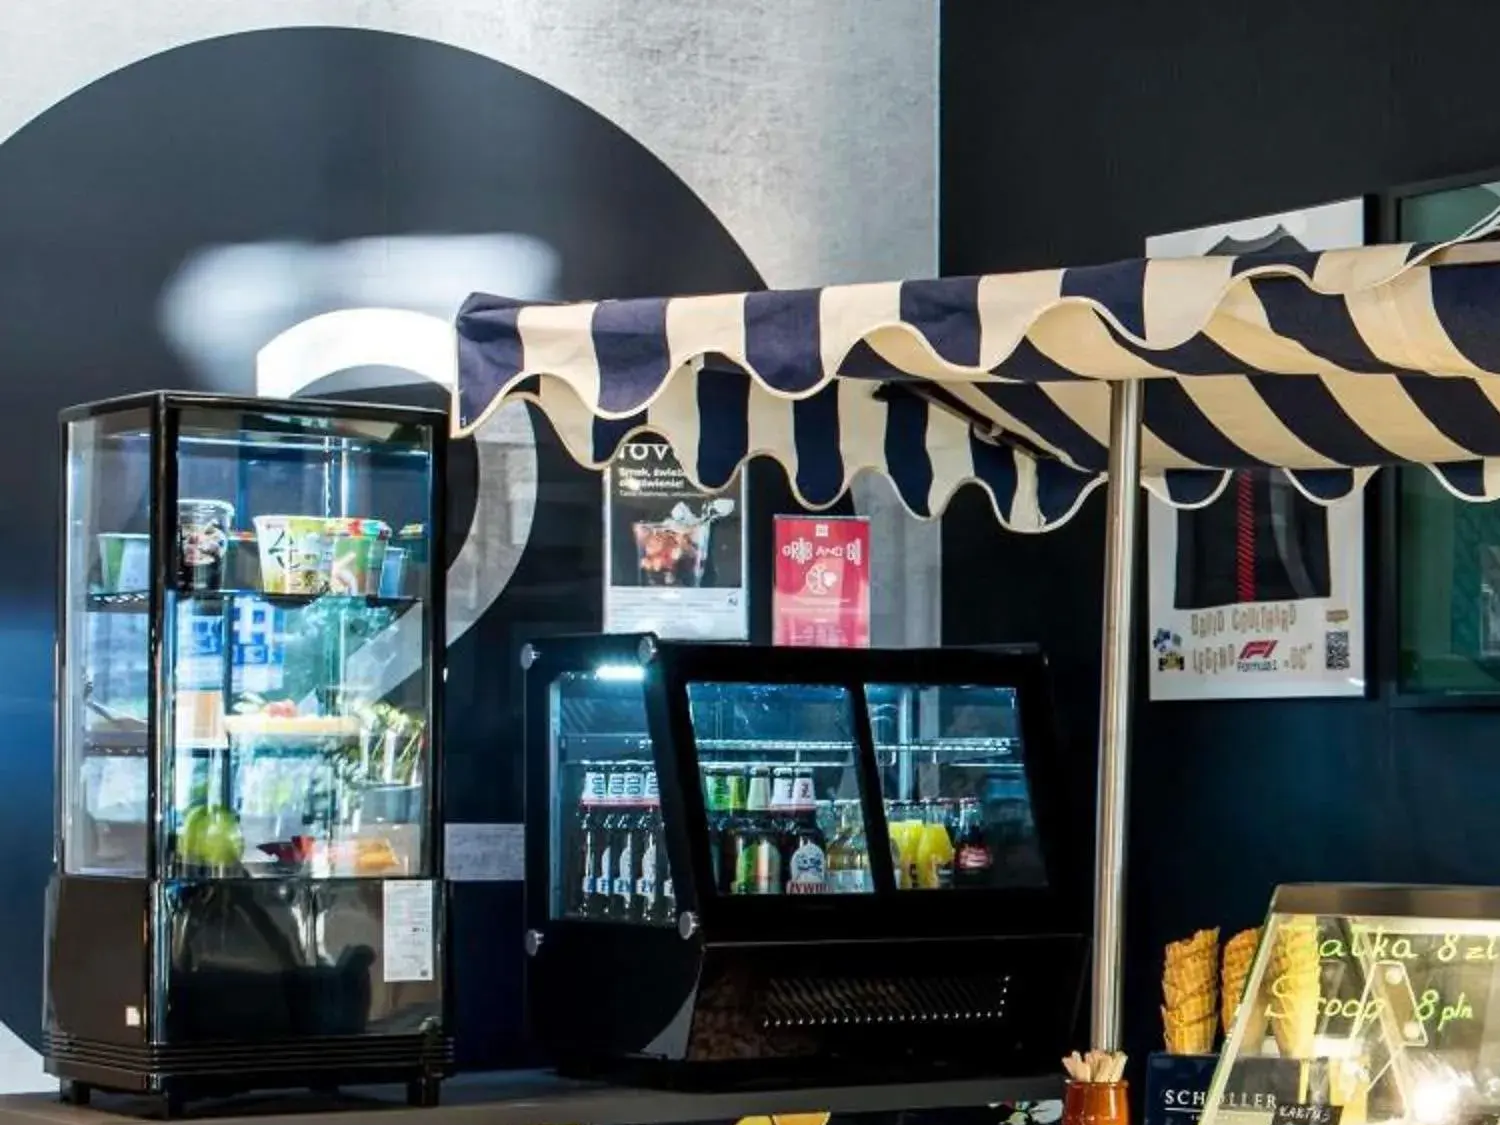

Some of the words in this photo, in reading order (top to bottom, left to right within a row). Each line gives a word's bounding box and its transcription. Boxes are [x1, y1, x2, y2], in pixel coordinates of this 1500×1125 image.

[619, 443, 669, 460] OV
[1438, 931, 1459, 962] 8
[1417, 989, 1440, 1021] 8
[1164, 1089, 1277, 1109] SCHLLER
